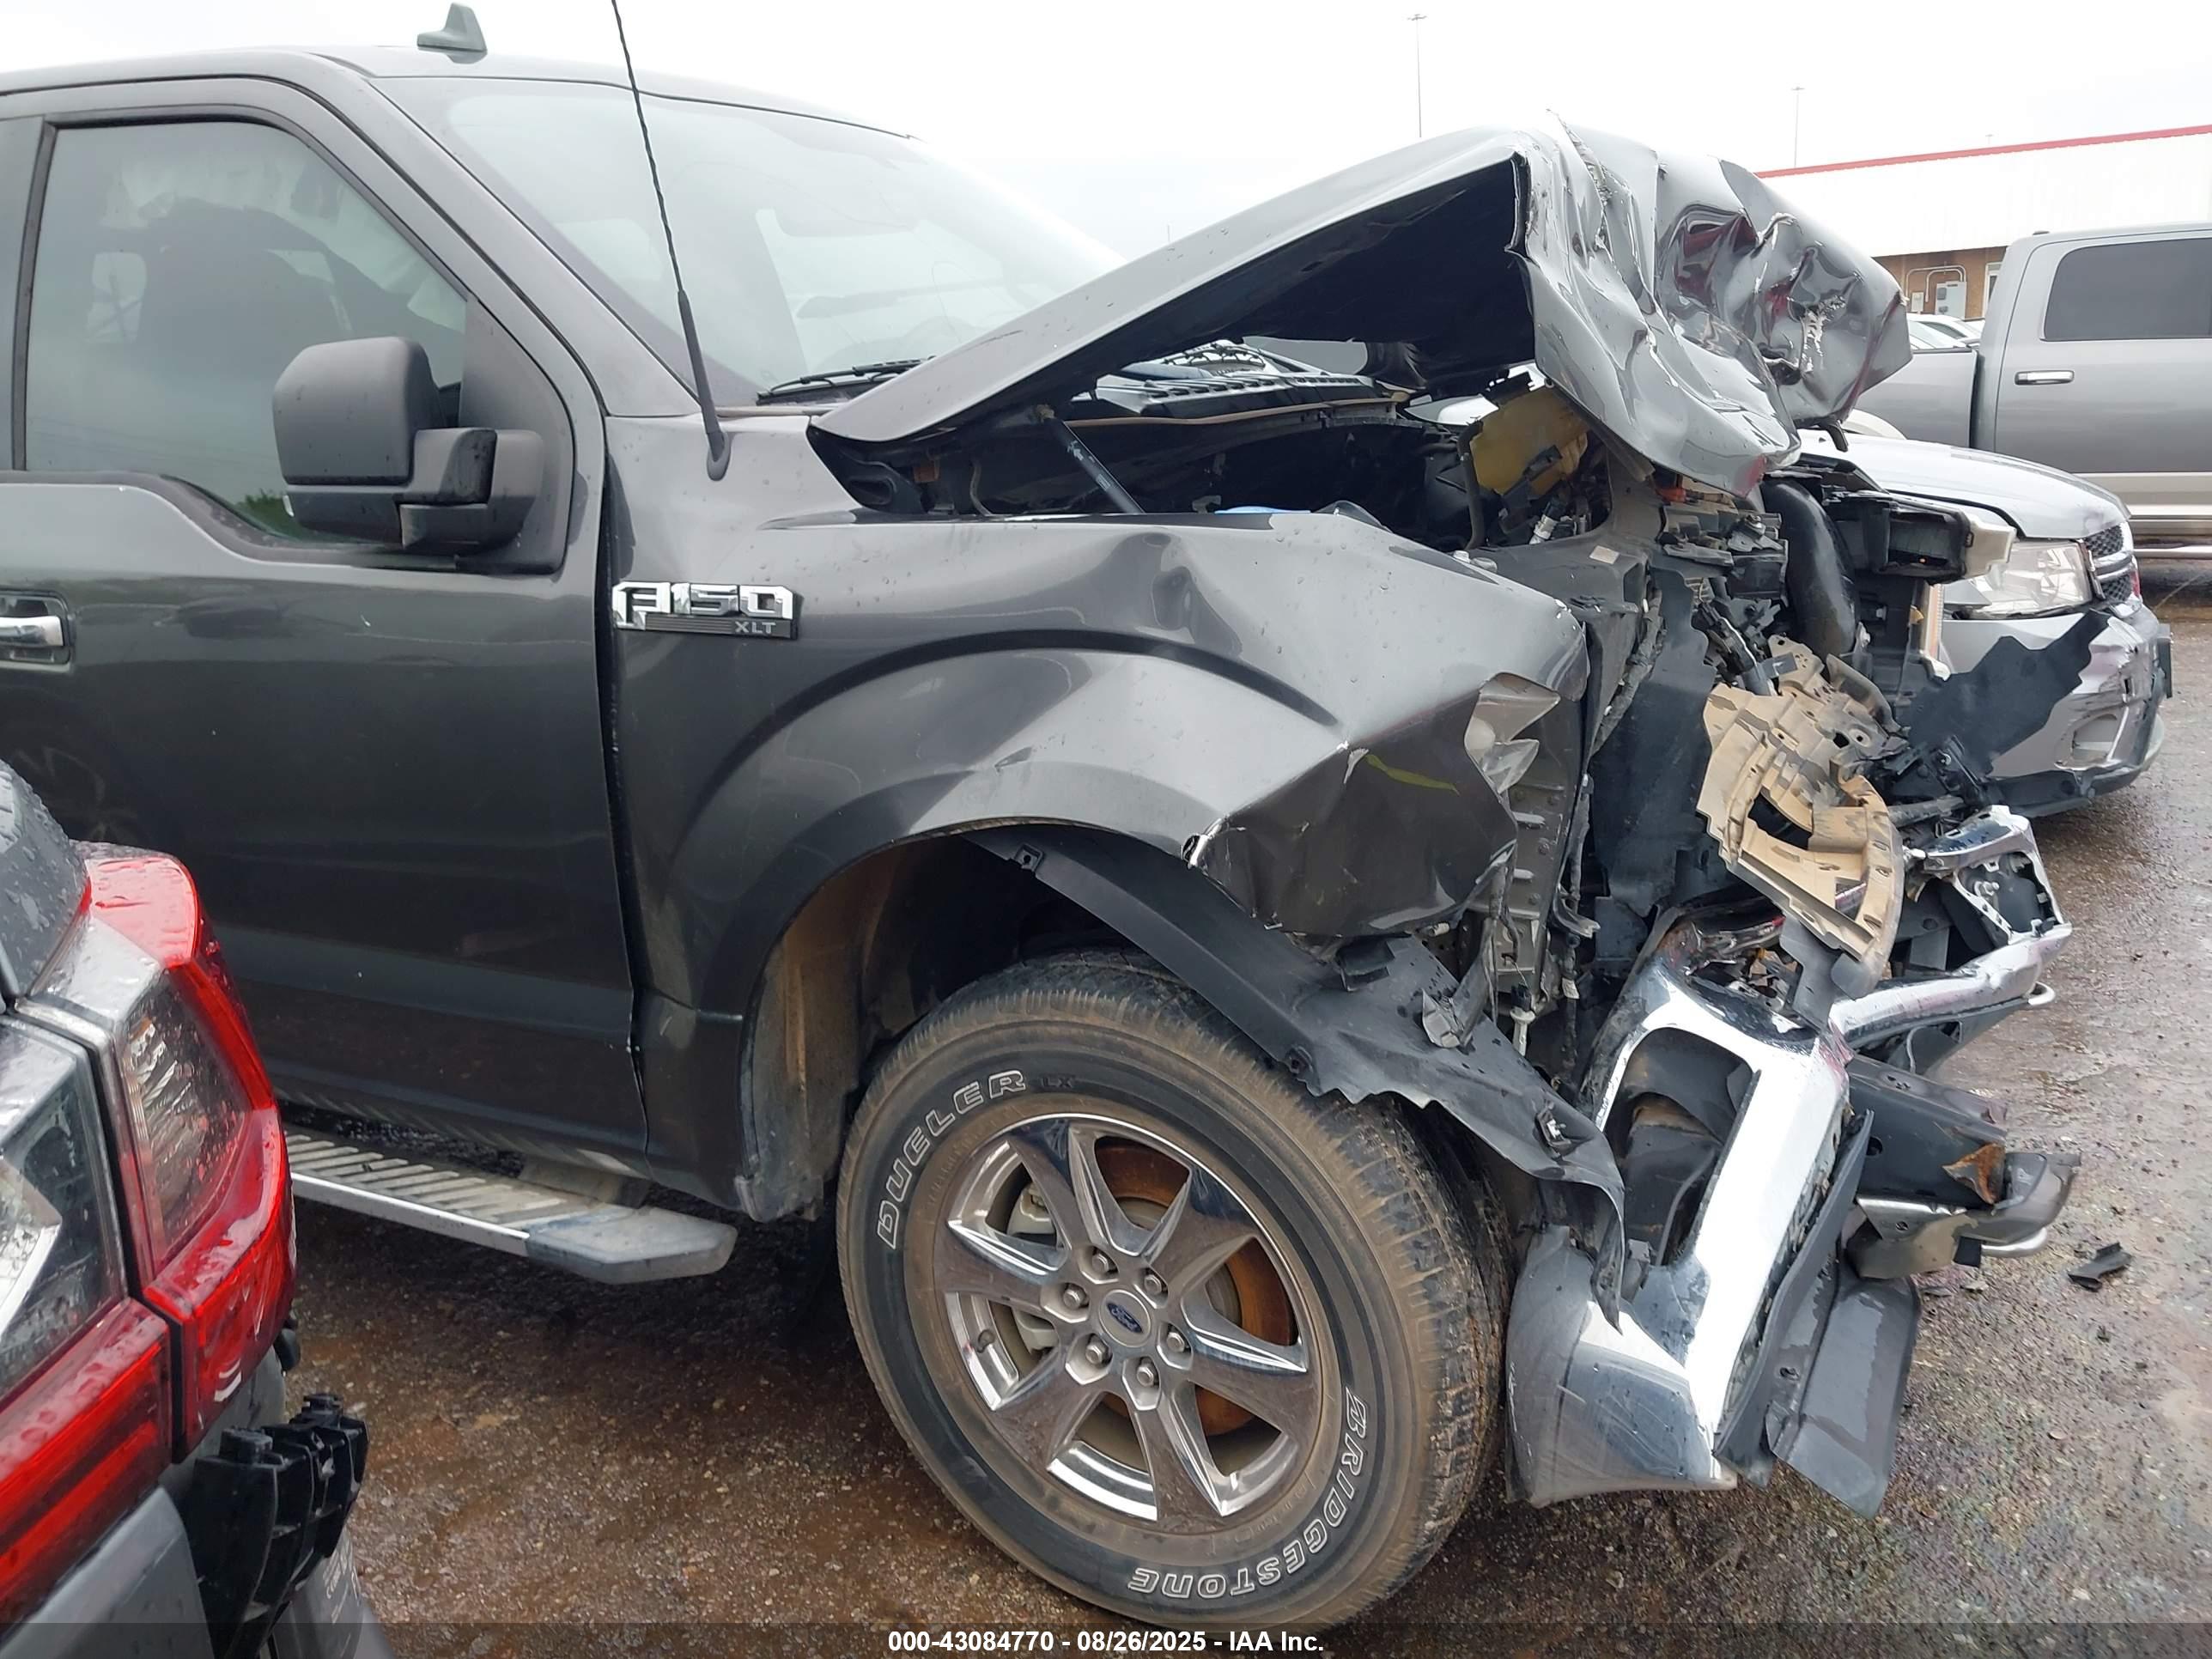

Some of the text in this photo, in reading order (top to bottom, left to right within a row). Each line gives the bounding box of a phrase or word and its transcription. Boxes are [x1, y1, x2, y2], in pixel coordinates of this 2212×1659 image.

[735, 621, 775, 634] XLT
[877, 1070, 1026, 1249] DUELER
[1109, 1304, 1141, 1333] Ford
[1127, 1386, 1367, 1599] BRIDGESTONE
